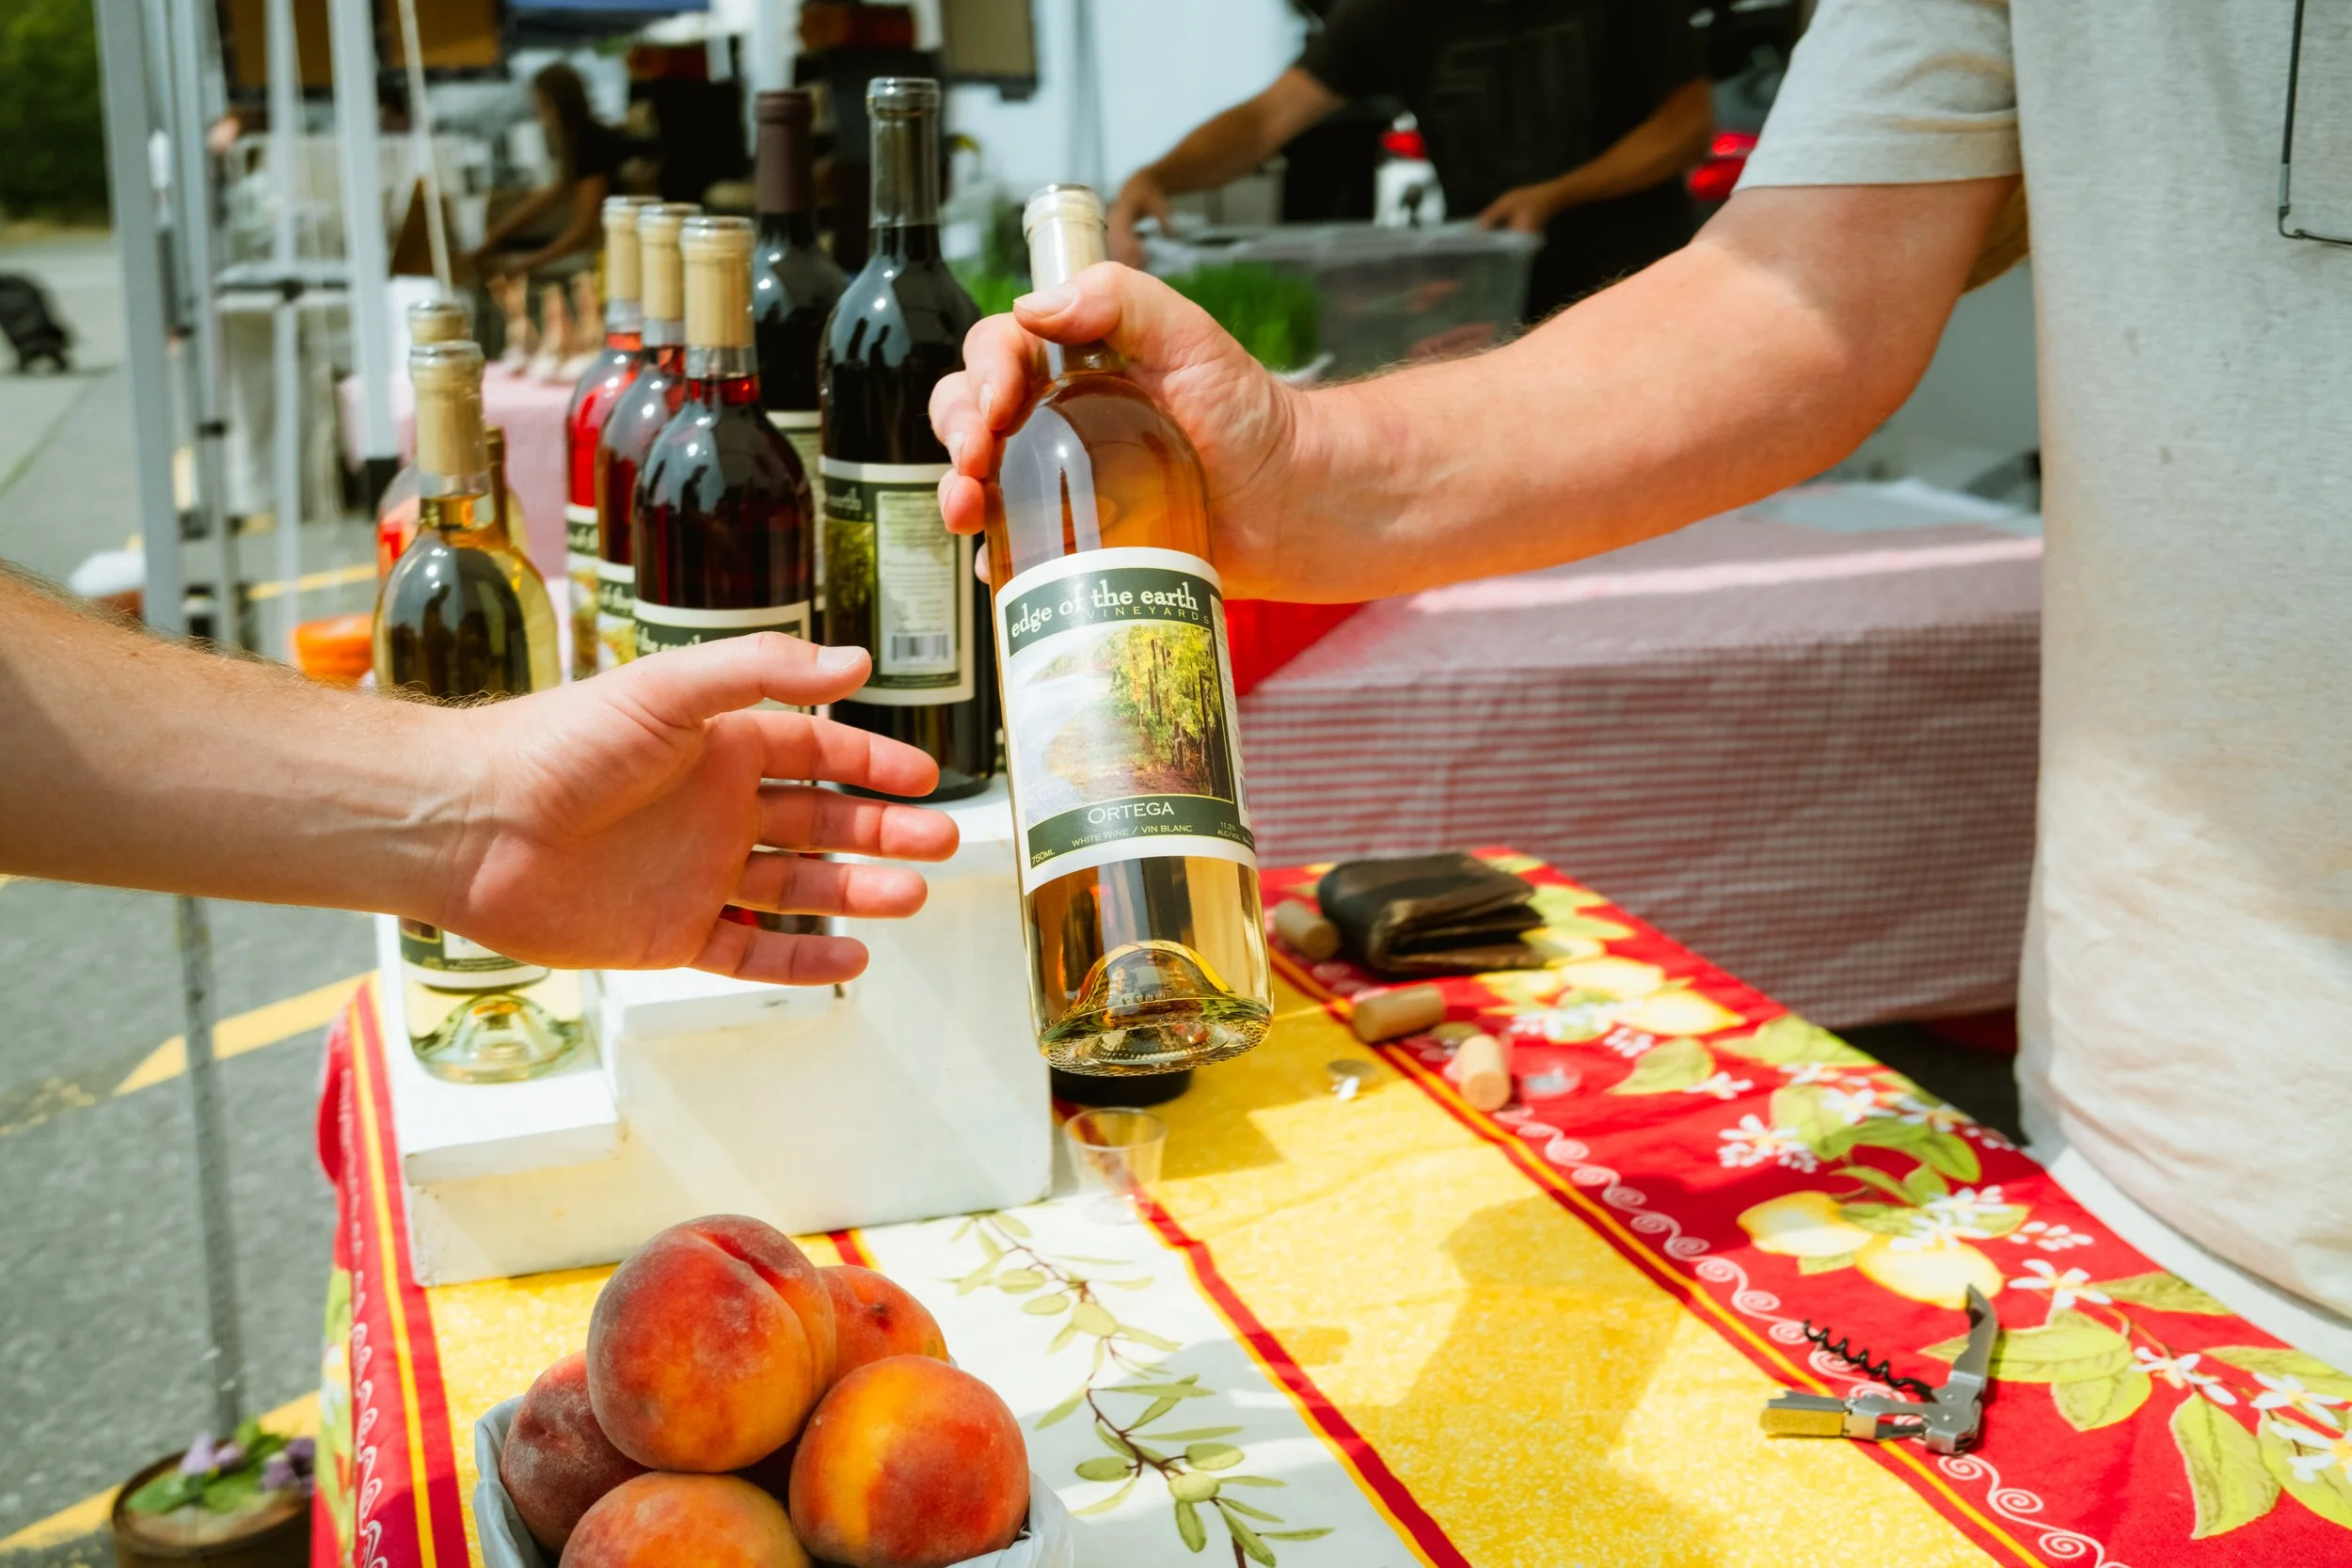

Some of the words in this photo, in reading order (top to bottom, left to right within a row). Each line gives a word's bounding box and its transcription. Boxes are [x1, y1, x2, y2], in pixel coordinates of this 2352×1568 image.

[1010, 602, 1053, 639] edge
[1058, 584, 1086, 616] of
[1090, 578, 1134, 609] the
[1139, 581, 1200, 611] earth
[1086, 605, 1211, 625] VINEYARDS
[1072, 832, 1102, 847] WHITE
[1104, 828, 1129, 839] WINE
[1141, 824, 1158, 834] VIN
[1160, 824, 1194, 833] BLANC
